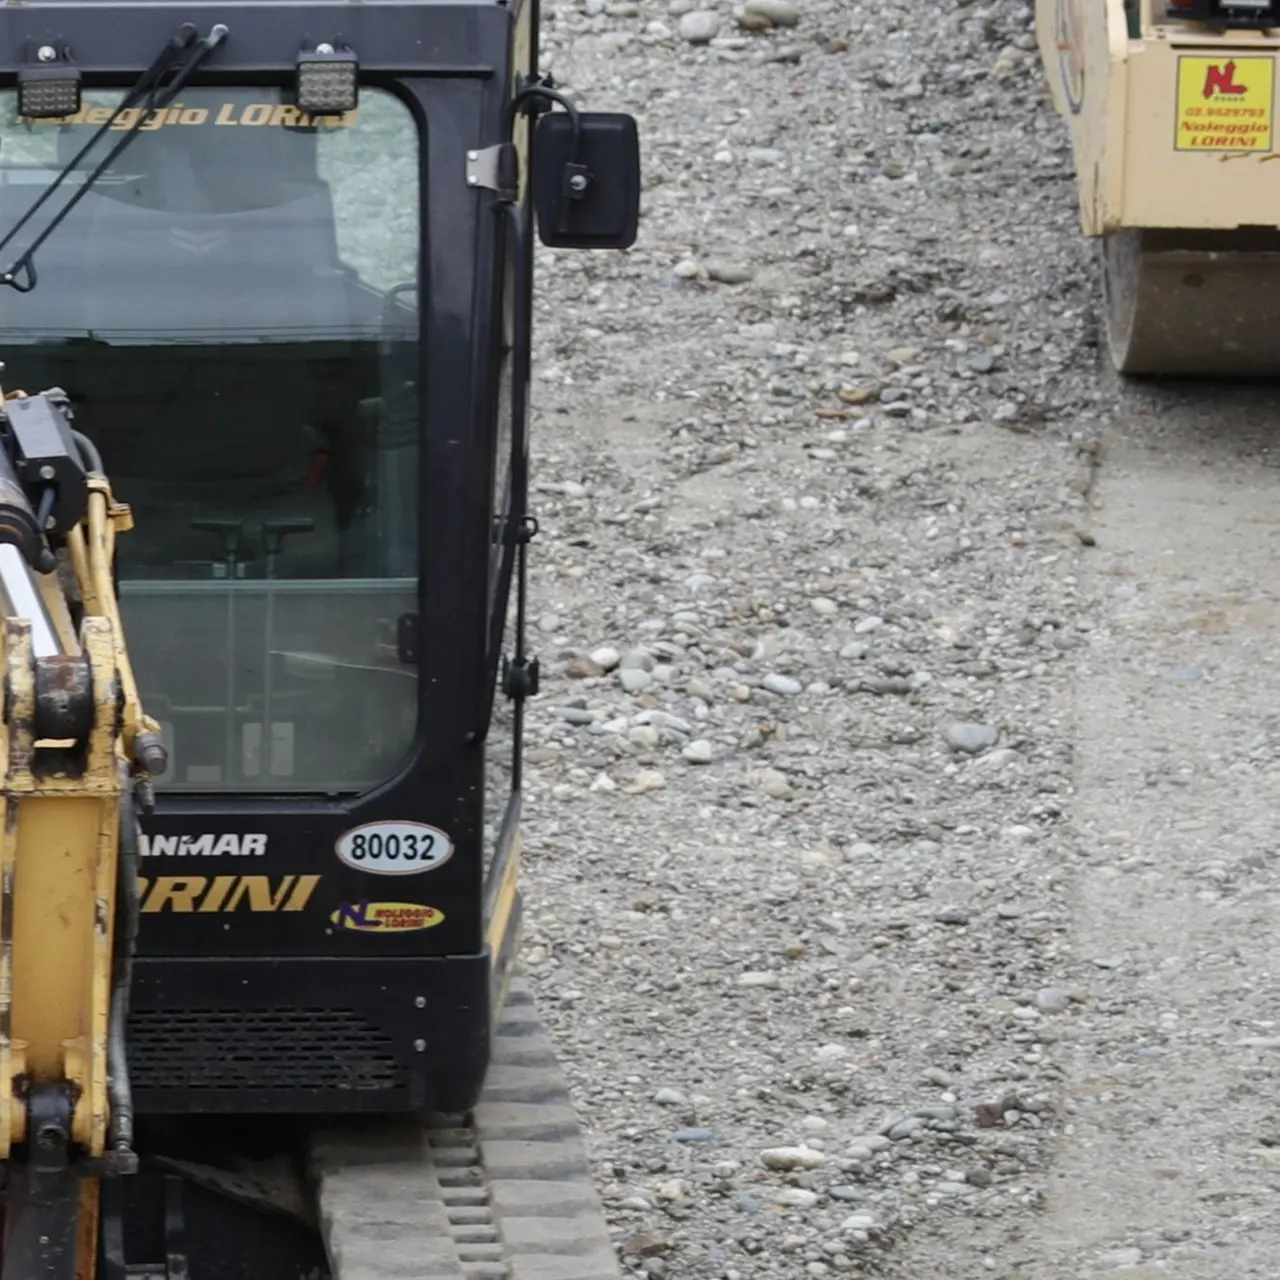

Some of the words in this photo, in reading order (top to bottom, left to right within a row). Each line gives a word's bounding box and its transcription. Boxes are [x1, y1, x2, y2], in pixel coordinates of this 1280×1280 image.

[16, 102, 209, 131] leggio
[1190, 136, 1258, 146] LORINI
[351, 833, 435, 860] 80032
[137, 875, 322, 912] RINI
